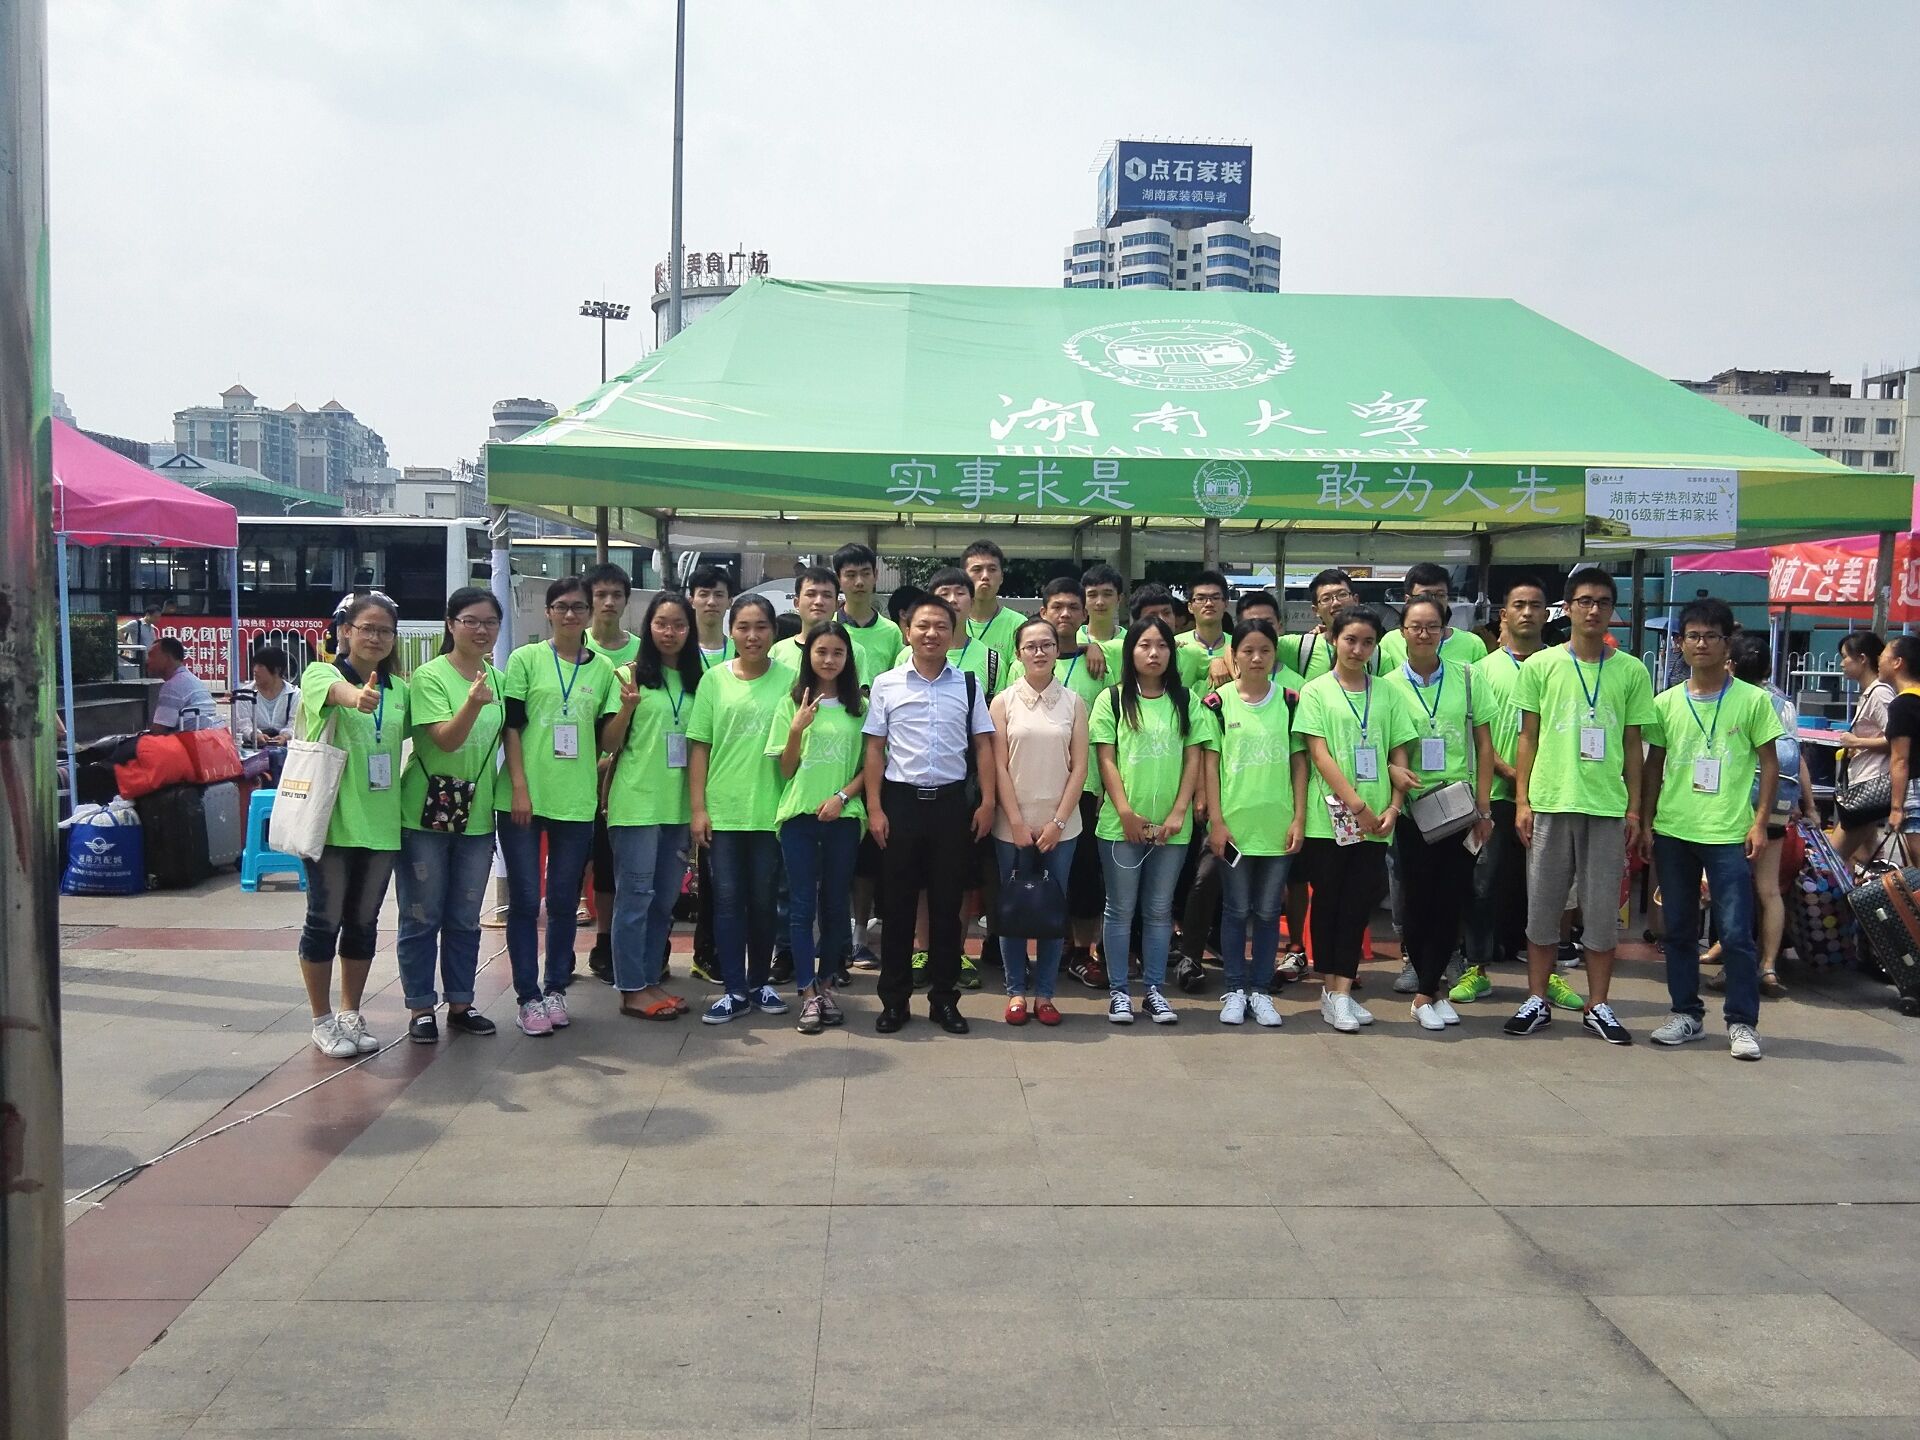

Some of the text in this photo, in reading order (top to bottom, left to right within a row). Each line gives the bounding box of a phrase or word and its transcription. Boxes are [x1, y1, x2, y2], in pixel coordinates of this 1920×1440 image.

[1148, 158, 1243, 184] 点石家装
[1141, 189, 1228, 204] 湖南家装领导者
[885, 456, 1561, 515] 实事求是 敢为人先
[1609, 490, 1718, 505] 湖南大学热烈欢迎
[1608, 507, 1719, 522] 2016级新生和家长
